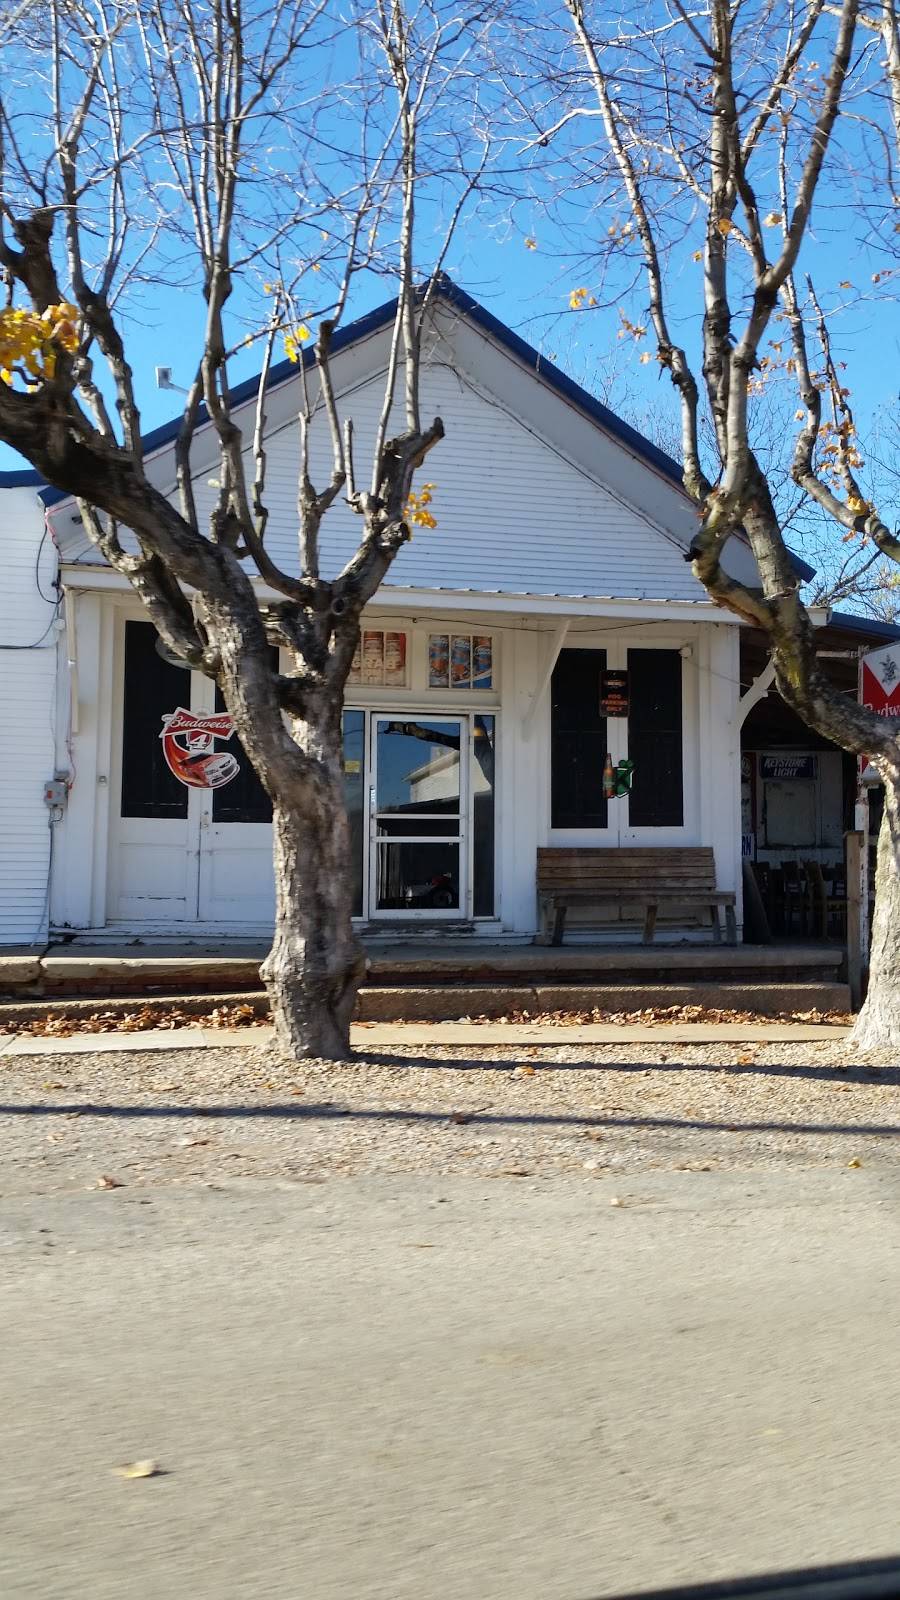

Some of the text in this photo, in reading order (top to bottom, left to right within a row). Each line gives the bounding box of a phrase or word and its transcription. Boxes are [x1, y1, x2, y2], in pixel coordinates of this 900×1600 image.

[189, 733, 207, 749] 4
[764, 758, 807, 768] KEYSTONE
[773, 767, 799, 777] LIGHT
